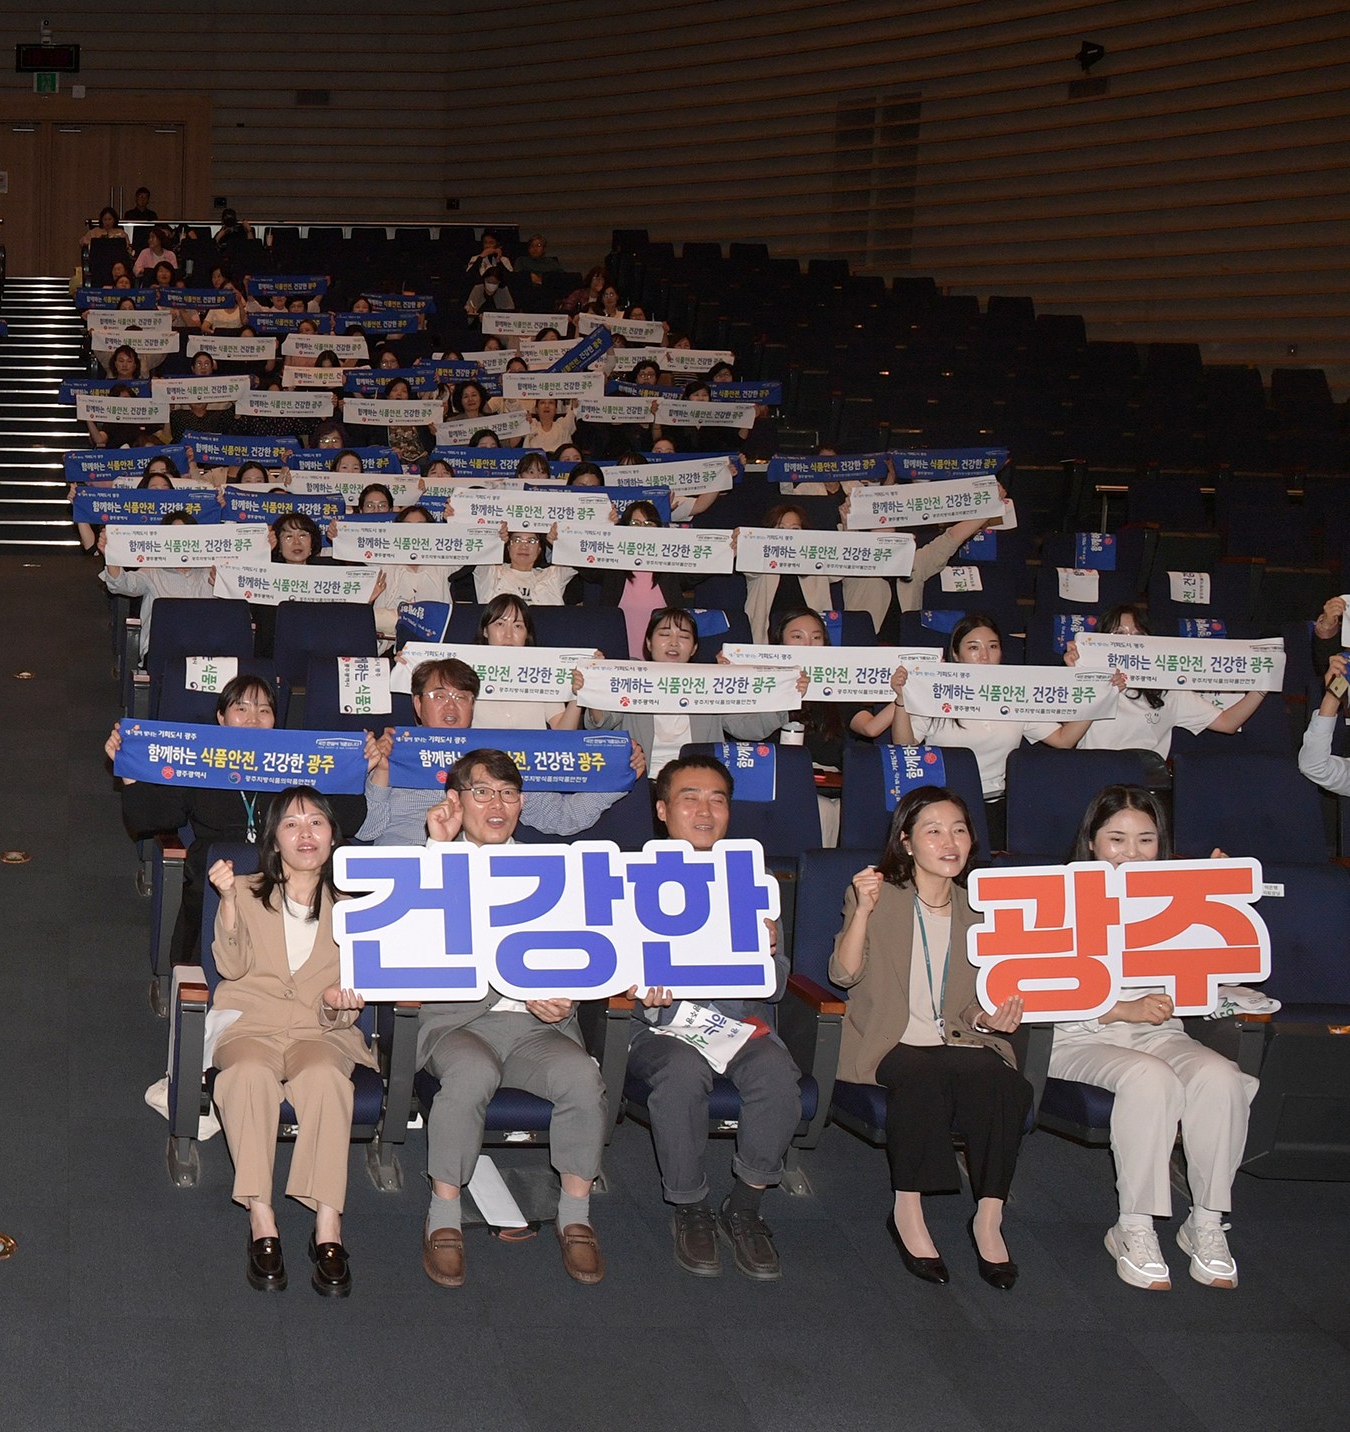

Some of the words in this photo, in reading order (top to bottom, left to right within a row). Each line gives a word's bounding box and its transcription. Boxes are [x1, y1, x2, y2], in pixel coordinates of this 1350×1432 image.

[471, 504, 503, 516] 함께하는
[506, 505, 544, 519] 식품안전,
[548, 507, 575, 520] 건강한
[577, 508, 595, 520] 광주
[872, 501, 904, 514] 함께하는
[906, 496, 943, 511] 식품안전,
[946, 493, 971, 508] 건강한
[974, 491, 991, 505] 광주
[129, 540, 161, 552] 함께하는
[164, 540, 202, 553] 식품안전,
[205, 539, 232, 552] 건강한
[234, 539, 252, 552] 광주
[358, 537, 390, 549] 함께하는
[393, 538, 432, 551] 식품안전,
[435, 538, 463, 551] 건강한
[465, 539, 483, 552] 광주
[580, 540, 614, 554] 함께하는
[617, 542, 658, 557] 식품안전,
[661, 544, 690, 558] 건강한
[693, 546, 712, 559] 광주
[763, 545, 796, 558] 함께하는
[799, 546, 838, 560] 식품안전,
[842, 547, 871, 561] 건강한
[873, 548, 891, 561] 광주
[238, 575, 270, 590] 함께하는
[273, 579, 310, 593] 식품안전,
[314, 581, 341, 594] 건강한
[343, 582, 361, 594] 광주
[1108, 653, 1151, 670] 함께하는
[1155, 655, 1206, 673] 식품안전,
[1211, 656, 1247, 673] 건강한
[1250, 657, 1274, 673] 광주
[610, 677, 653, 693] 함께하는
[657, 677, 708, 694] 식품안전,
[713, 677, 749, 694] 건강한
[752, 677, 776, 693] 광주
[933, 683, 975, 700] 함께하는
[979, 685, 1028, 703] 식품안전,
[1033, 686, 1069, 703] 건강한
[1072, 687, 1096, 703] 광주
[158, 730, 182, 739] 기회도시
[148, 744, 197, 765] 함께하는
[201, 748, 258, 771] 식품안전,
[263, 752, 304, 773] 건강한
[307, 755, 334, 774] 광주
[534, 752, 575, 771] 건강한
[578, 753, 605, 771] 광주
[345, 850, 770, 989] 건강한
[976, 867, 1262, 1012] 광주
